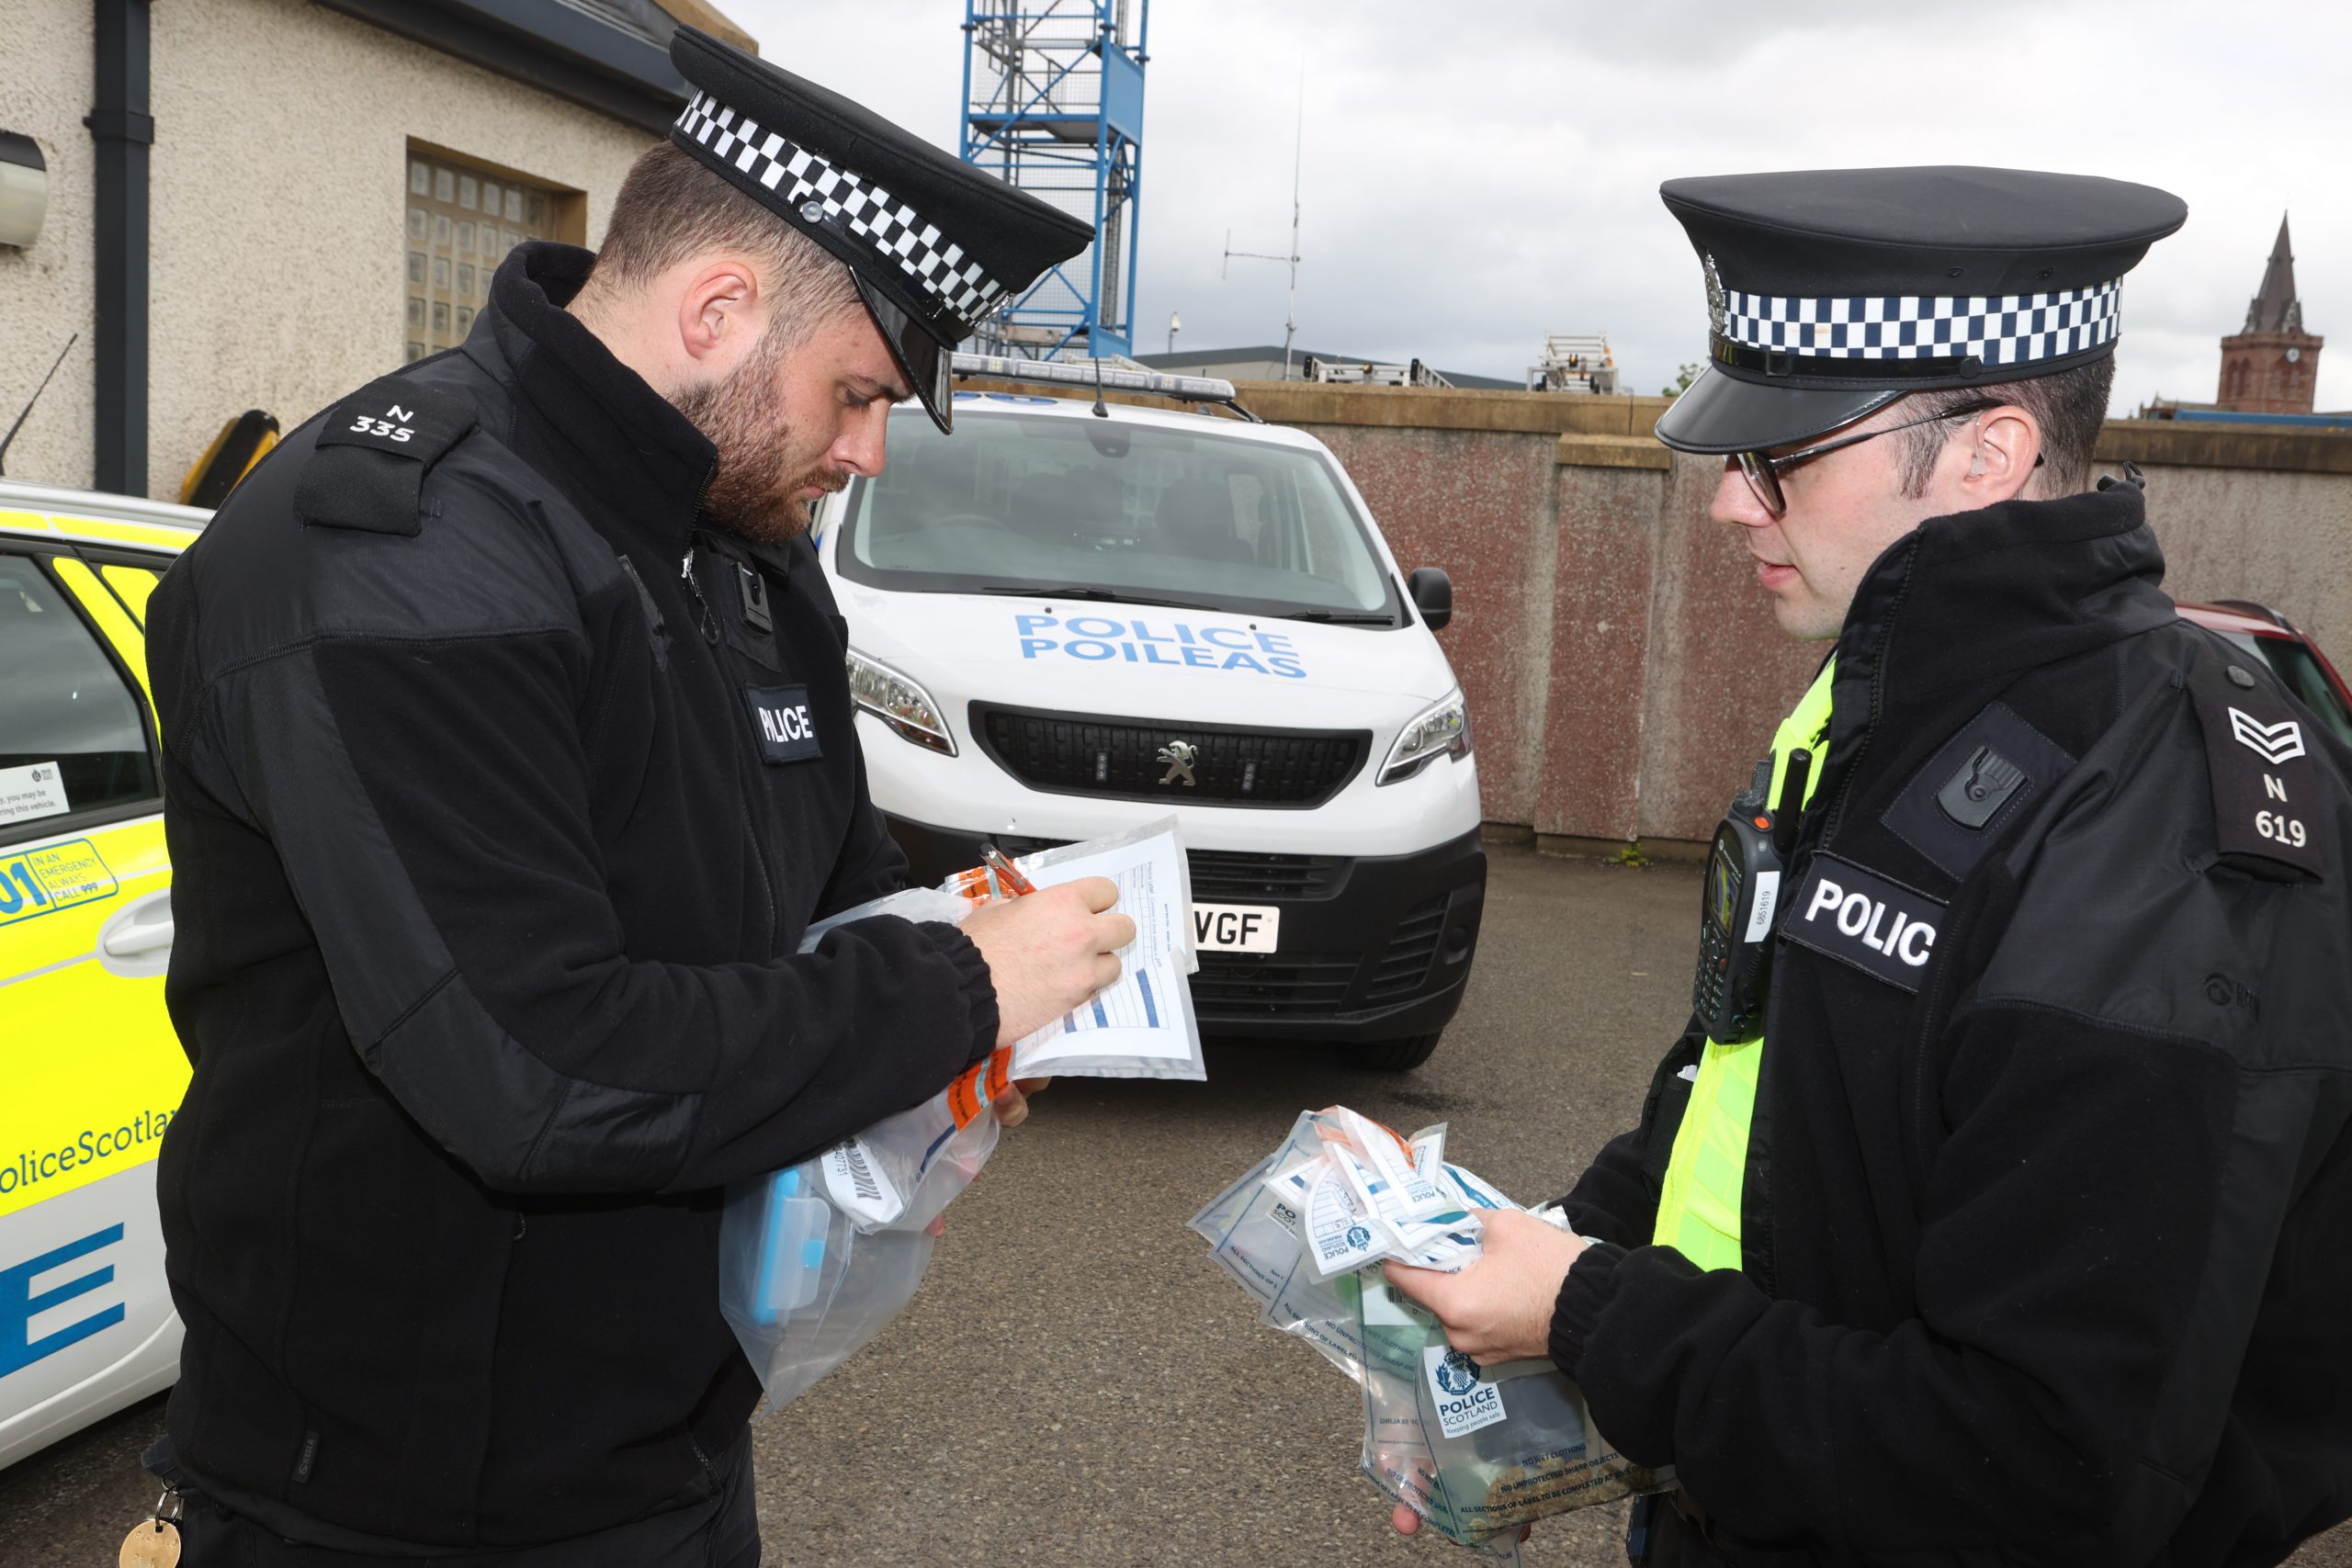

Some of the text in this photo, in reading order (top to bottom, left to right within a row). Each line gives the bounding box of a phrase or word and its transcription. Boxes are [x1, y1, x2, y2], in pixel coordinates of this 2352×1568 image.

[386, 404, 414, 423] N
[349, 415, 415, 443] 335
[1014, 614, 1299, 658] POLICE
[1019, 638, 1307, 679] POILEAS
[758, 705, 814, 743] PLICE
[2263, 773, 2288, 803] N
[2255, 810, 2307, 848] 619
[32, 852, 61, 866] IN AN
[39, 857, 96, 879] EMERGENCY
[49, 873, 88, 890] ALWAYS
[54, 882, 99, 903] CALL 999
[1756, 890, 1771, 925] 6851619
[1193, 910, 1262, 945] VGF
[0, 1110, 177, 1193] oliceScotla
[1323, 1247, 1349, 1260] POLICE
[1439, 1387, 1496, 1416] POLICE
[1442, 1401, 1498, 1427] SCOTLAND
[1446, 1411, 1501, 1434] Keeping people safe
[1521, 1456, 1534, 1467] NO
[1550, 1443, 1588, 1461] CLOTHING
[1500, 1451, 1620, 1494] NO UNPROTECTED SHARP OBJECTS
[1474, 1502, 1508, 1514] SECTIONS
[1508, 1500, 1518, 1510] OF
[1518, 1495, 1541, 1508] LABEL
[1552, 1489, 1562, 1499] BE
[1562, 1475, 1604, 1495] COMPLETED
